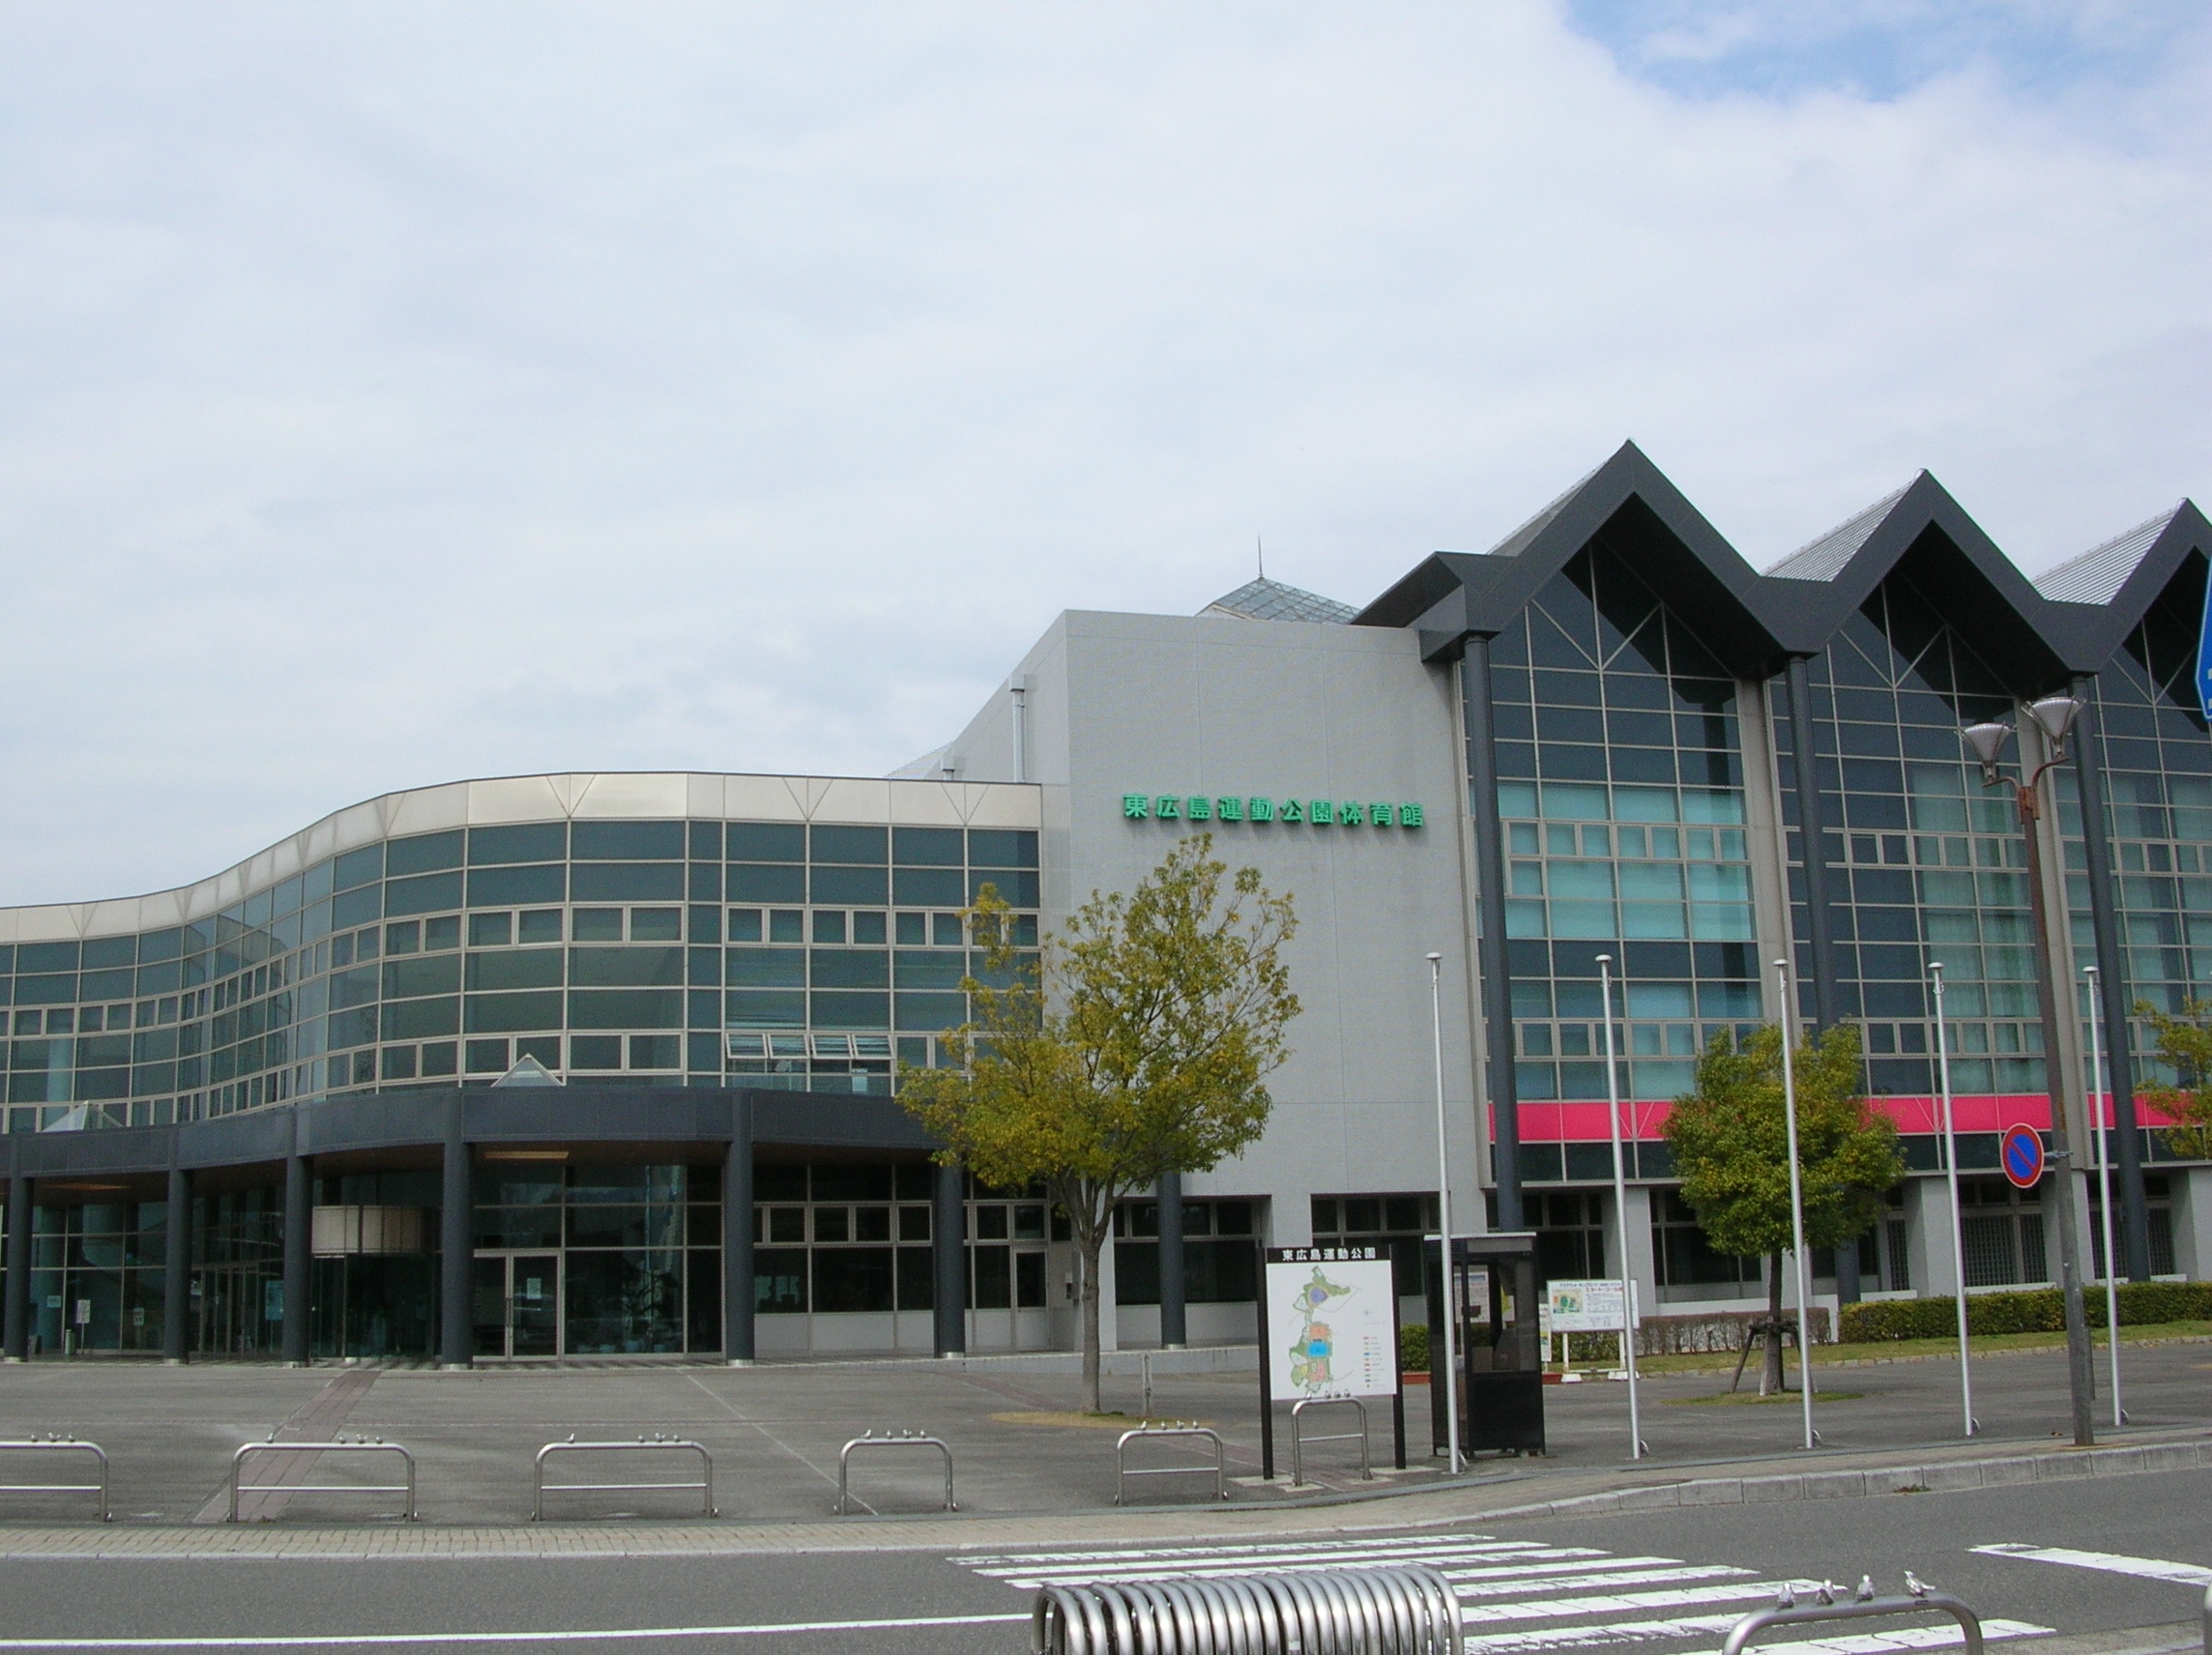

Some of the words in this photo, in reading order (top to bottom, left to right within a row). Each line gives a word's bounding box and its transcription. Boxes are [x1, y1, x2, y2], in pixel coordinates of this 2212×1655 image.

[1122, 793, 1424, 827] 東広島運動公園体育館
[1282, 1247, 1376, 1261] 東広島運動公園
